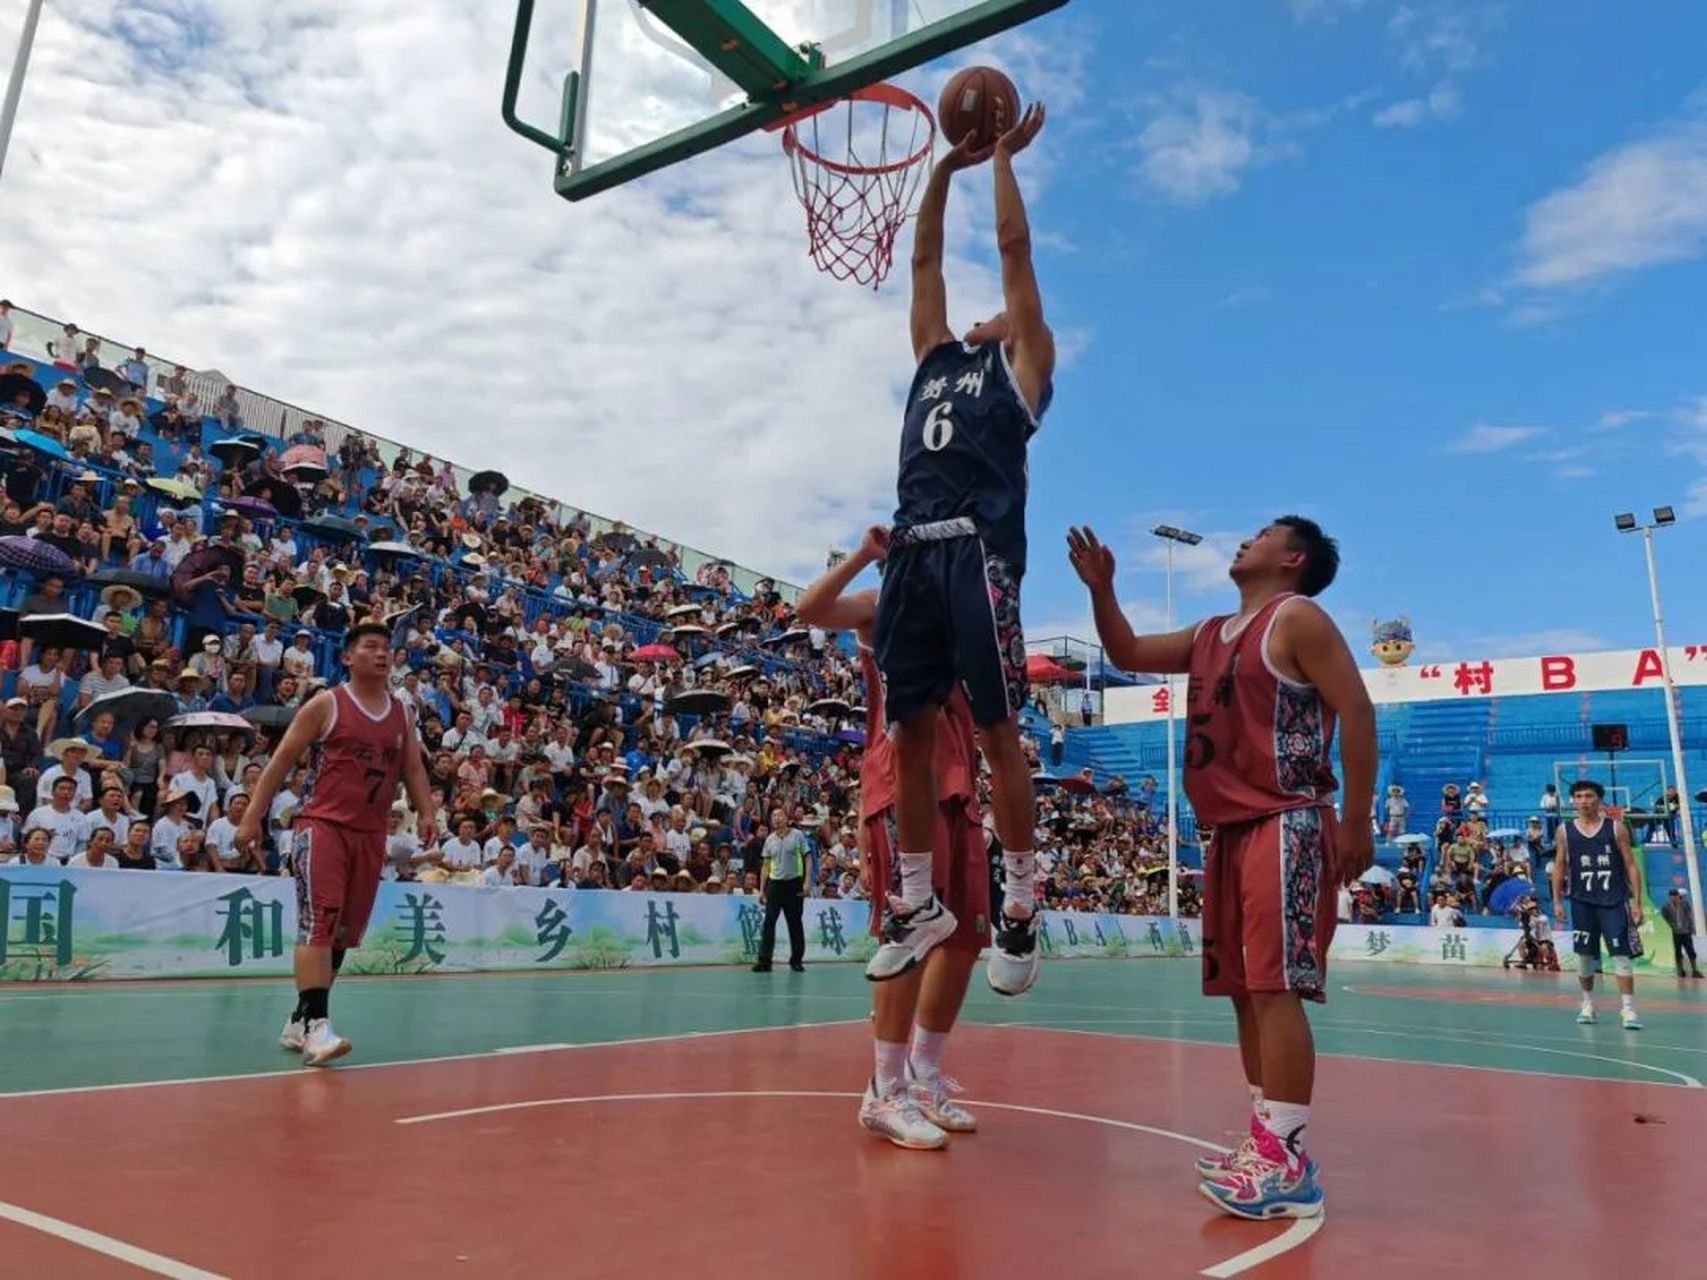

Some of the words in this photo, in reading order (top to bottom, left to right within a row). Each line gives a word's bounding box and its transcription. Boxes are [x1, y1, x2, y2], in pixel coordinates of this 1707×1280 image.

[922, 402, 954, 451] 6
[365, 767, 385, 804] 7
[1580, 870, 1612, 892] 77
